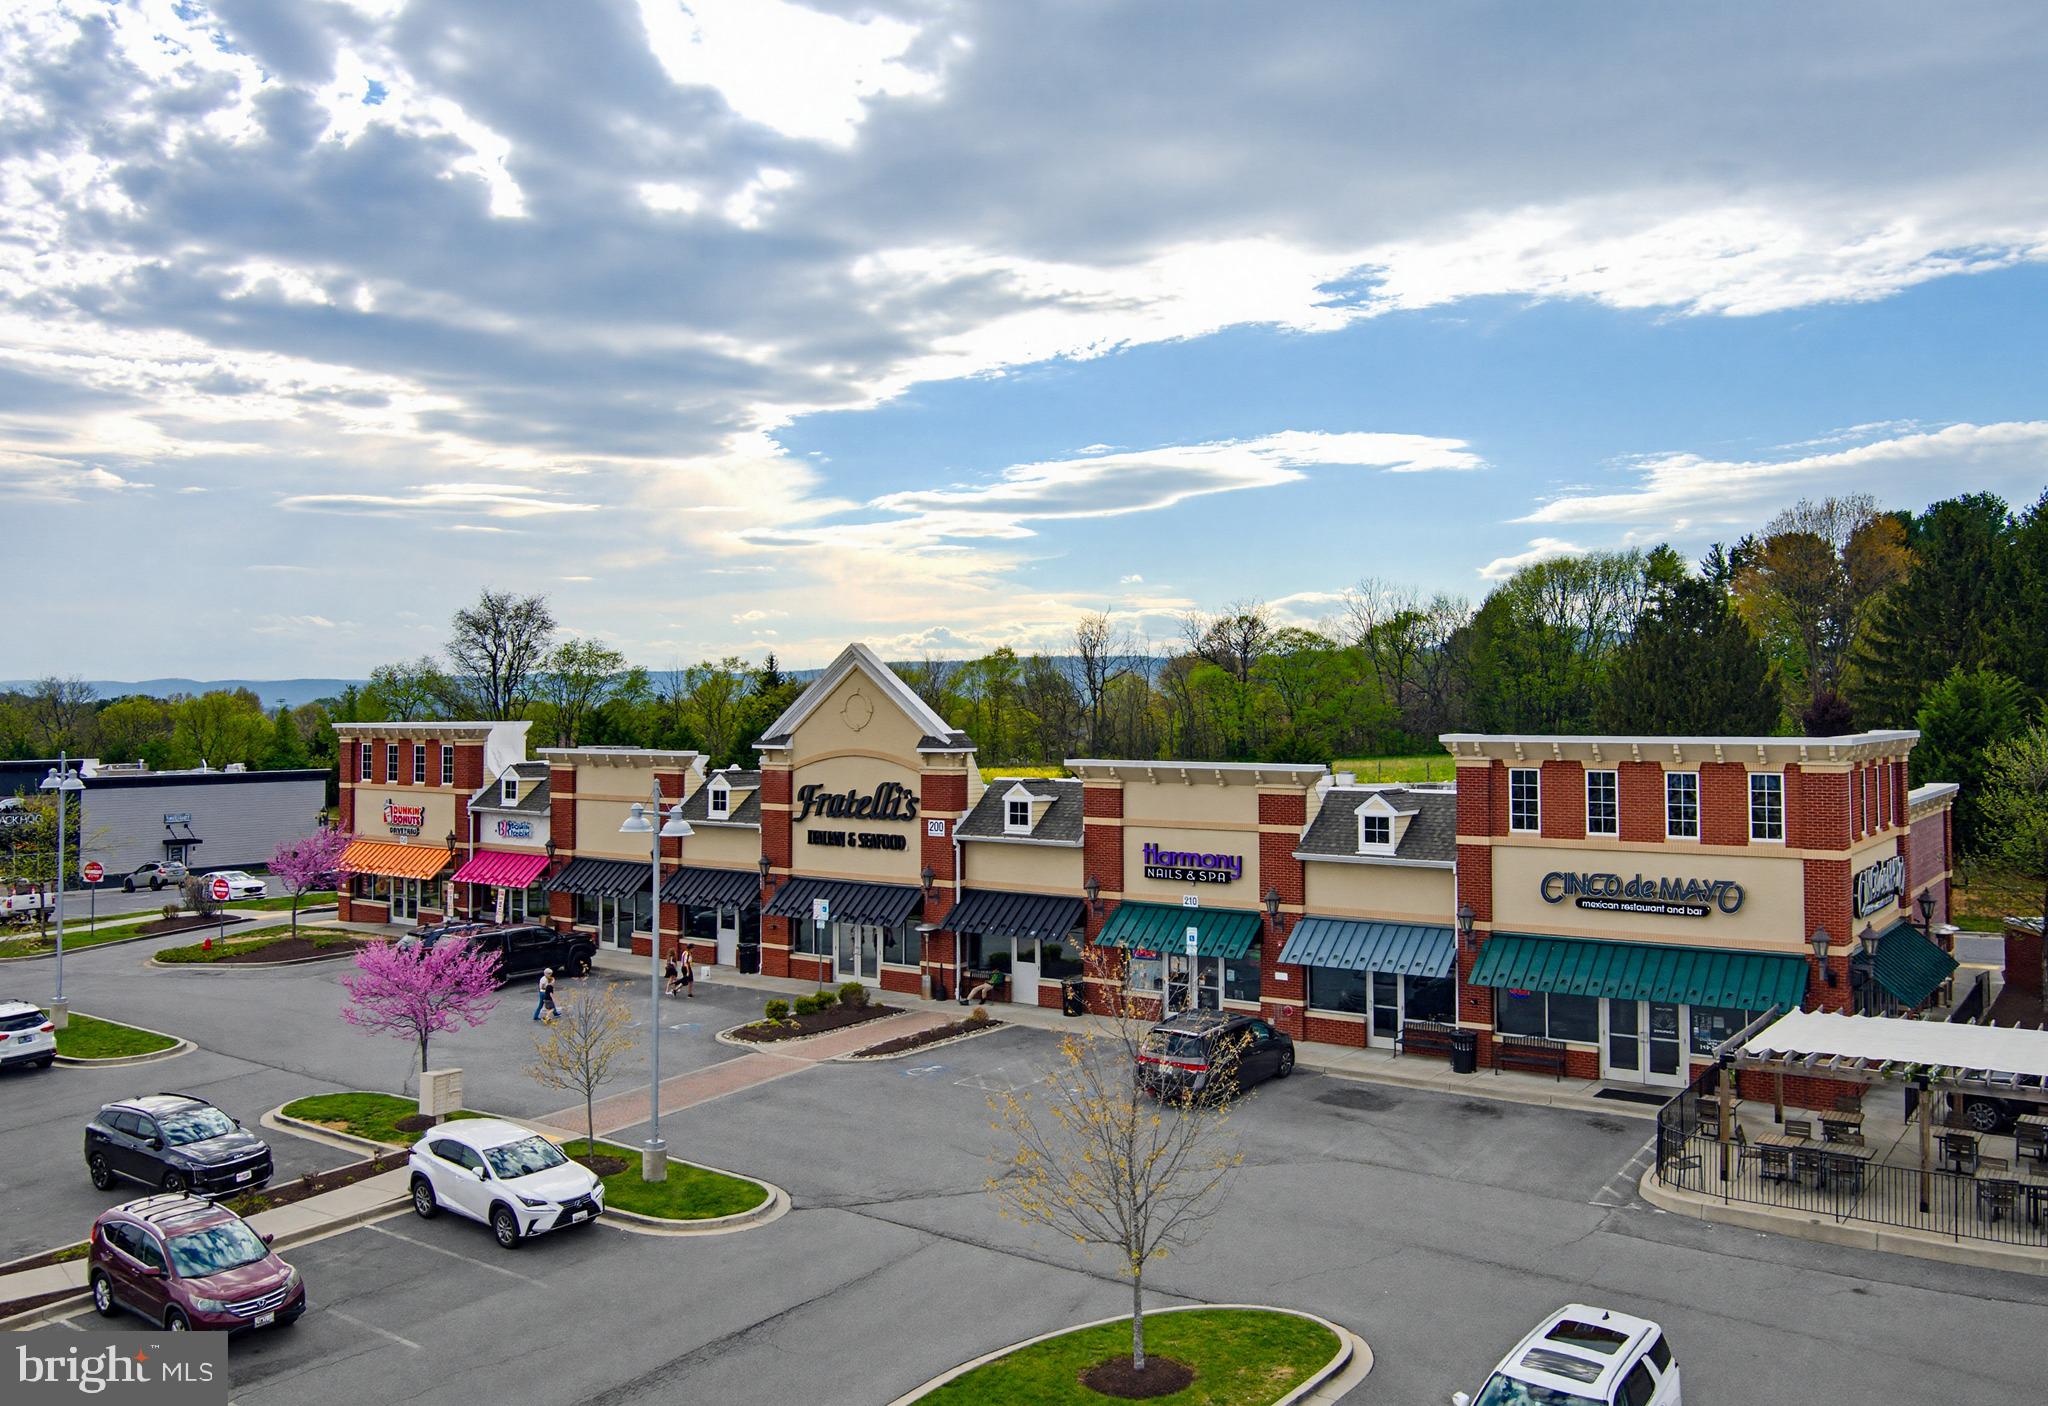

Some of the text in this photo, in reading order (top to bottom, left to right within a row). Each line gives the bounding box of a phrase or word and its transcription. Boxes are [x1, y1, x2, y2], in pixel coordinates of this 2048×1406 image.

[793, 782, 920, 822] Fratelli's
[393, 815, 420, 825] DONUTS
[929, 821, 944, 832] 200
[848, 832, 856, 848] &
[1143, 843, 1242, 880] Harmony
[1148, 868, 1226, 882] NAILS & SPA
[1184, 896, 1198, 906] 210
[1541, 872, 1745, 915] CINCO de MAYO
[1582, 901, 1703, 916] mexican restaurant and bar
